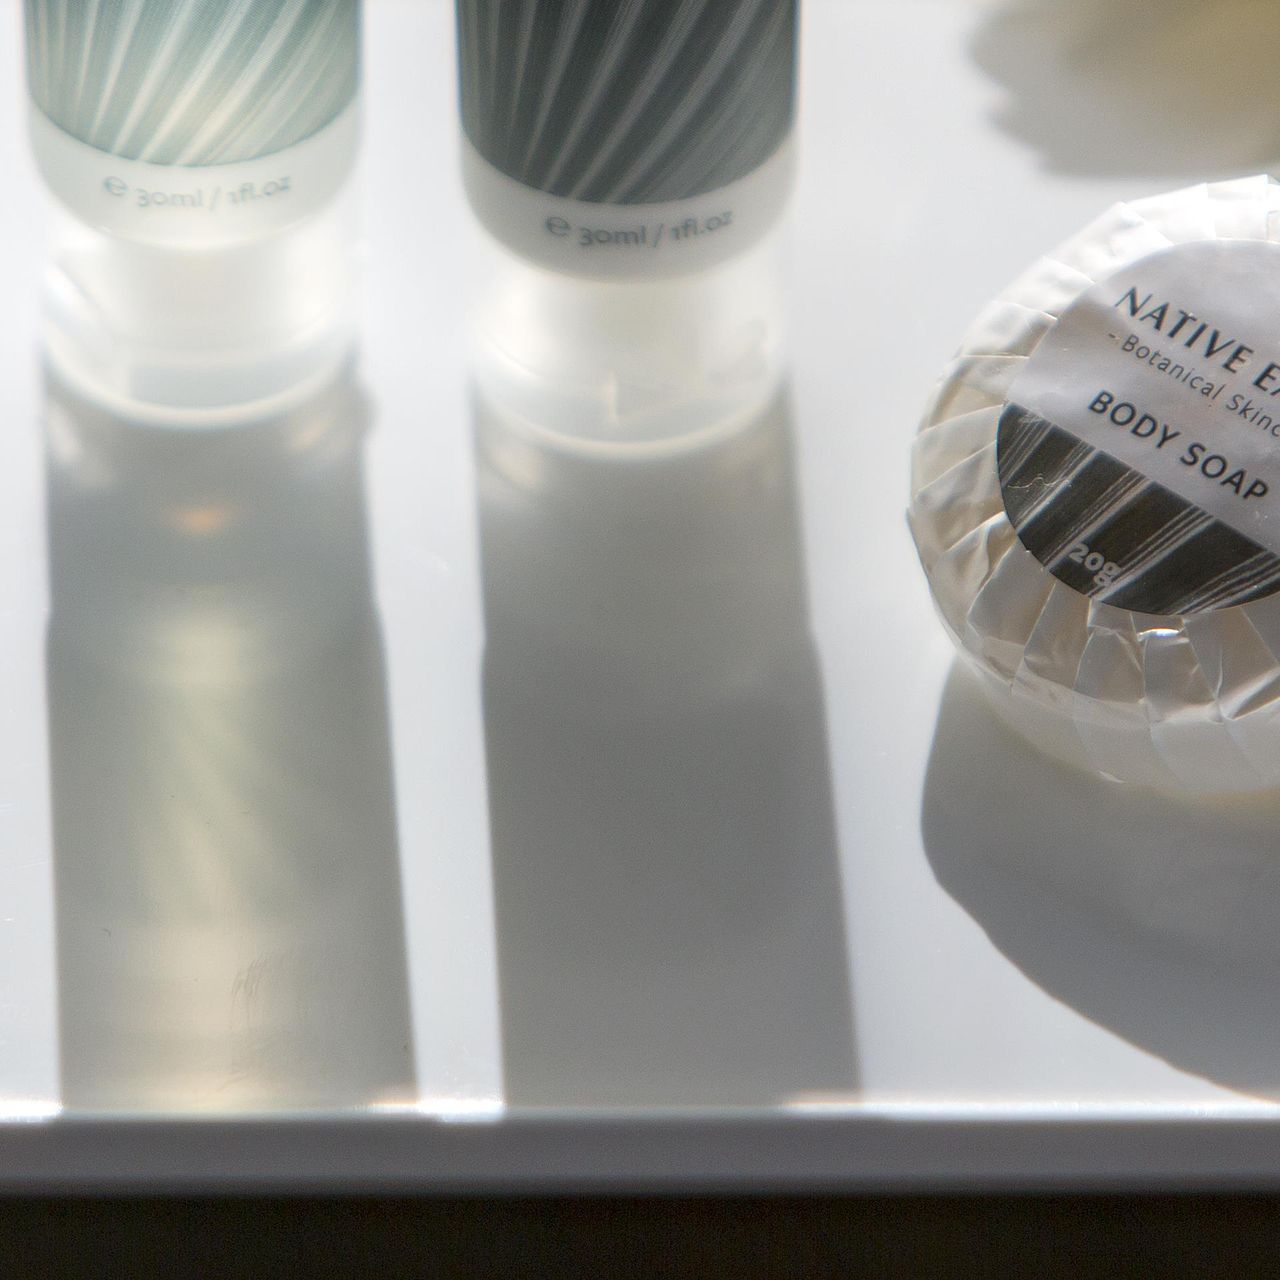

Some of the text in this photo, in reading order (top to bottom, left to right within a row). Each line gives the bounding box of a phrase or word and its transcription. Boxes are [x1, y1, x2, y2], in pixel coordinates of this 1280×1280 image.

[136, 188, 203, 207] 30ml
[578, 225, 646, 246] 30ml
[1116, 286, 1254, 374] NATIVE
[1121, 334, 1224, 400] Botanical
[1088, 390, 1269, 500] BODY SOAP
[1069, 542, 1121, 586] 20g
